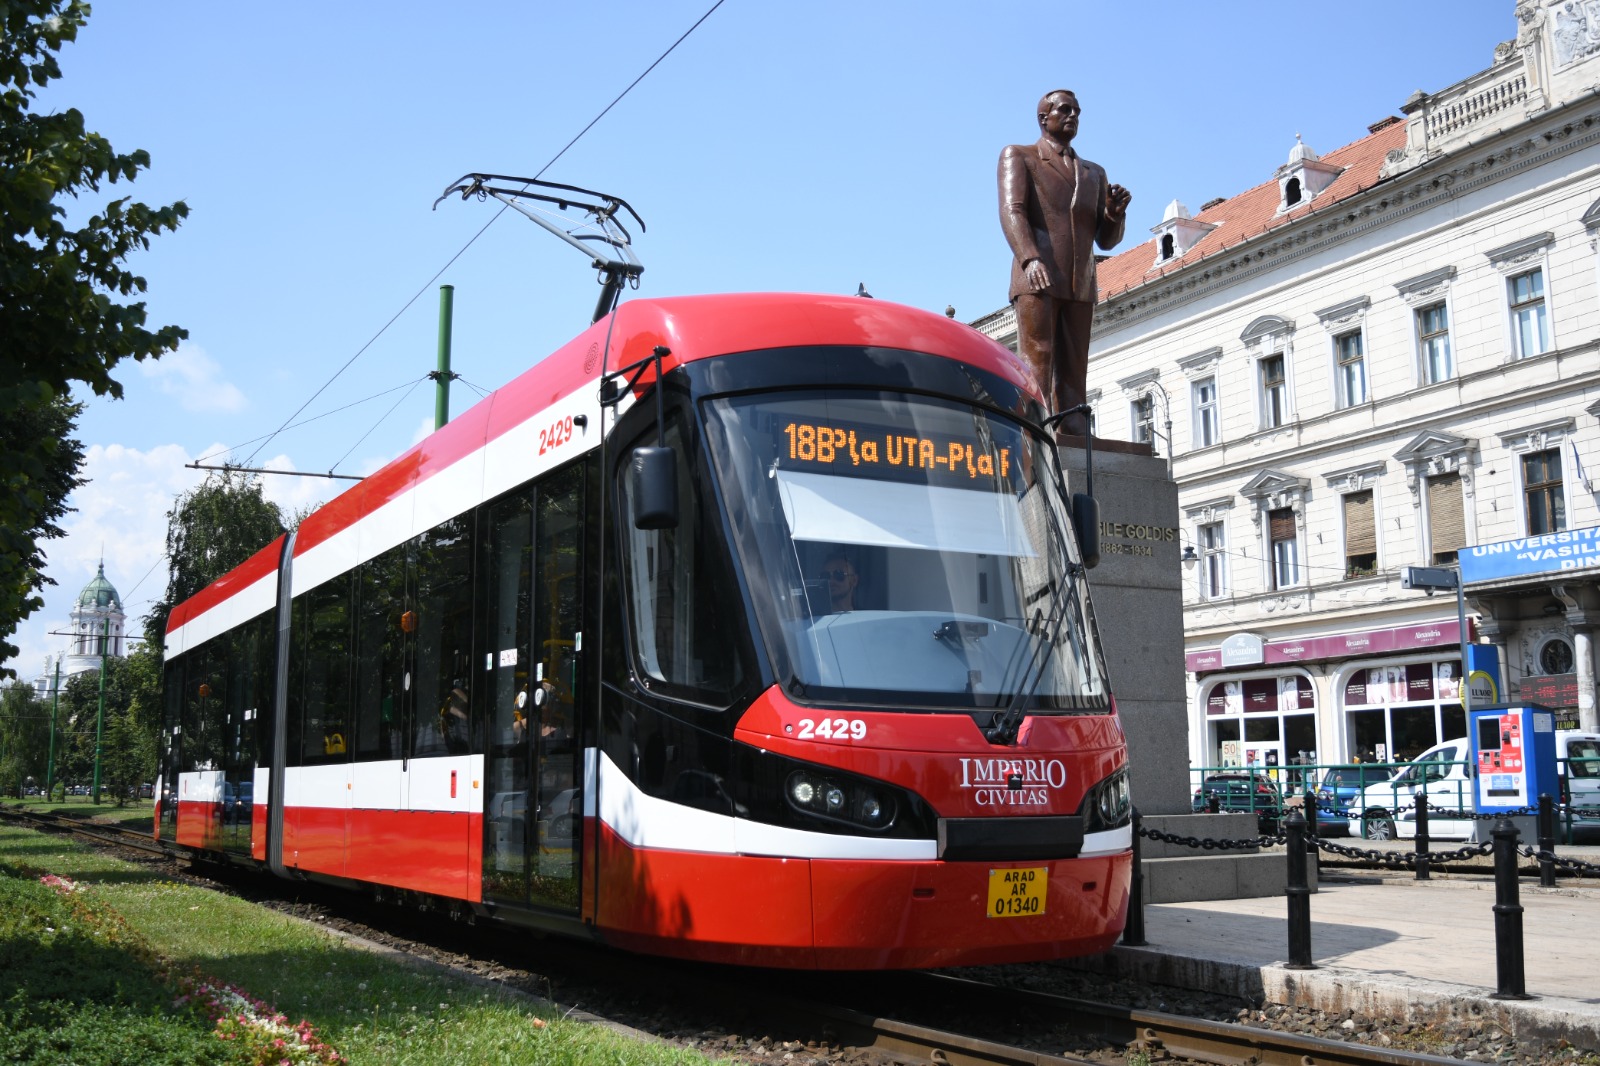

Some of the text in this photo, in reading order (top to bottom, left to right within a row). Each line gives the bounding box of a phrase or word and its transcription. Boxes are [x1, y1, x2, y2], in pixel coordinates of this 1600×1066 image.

[538, 415, 573, 456] 2429
[1125, 524, 1174, 542] GOLDIS
[1415, 629, 1441, 639] Alexandria
[1345, 638, 1370, 648] Alexandria
[1226, 646, 1257, 657] Alexandria
[797, 718, 867, 739] 2429
[959, 758, 1066, 788] IMPERIO
[975, 789, 1048, 805] CIVITAS
[1004, 871, 1035, 882] ARAD
[1011, 883, 1026, 896] AR
[995, 897, 1039, 914] 01340
